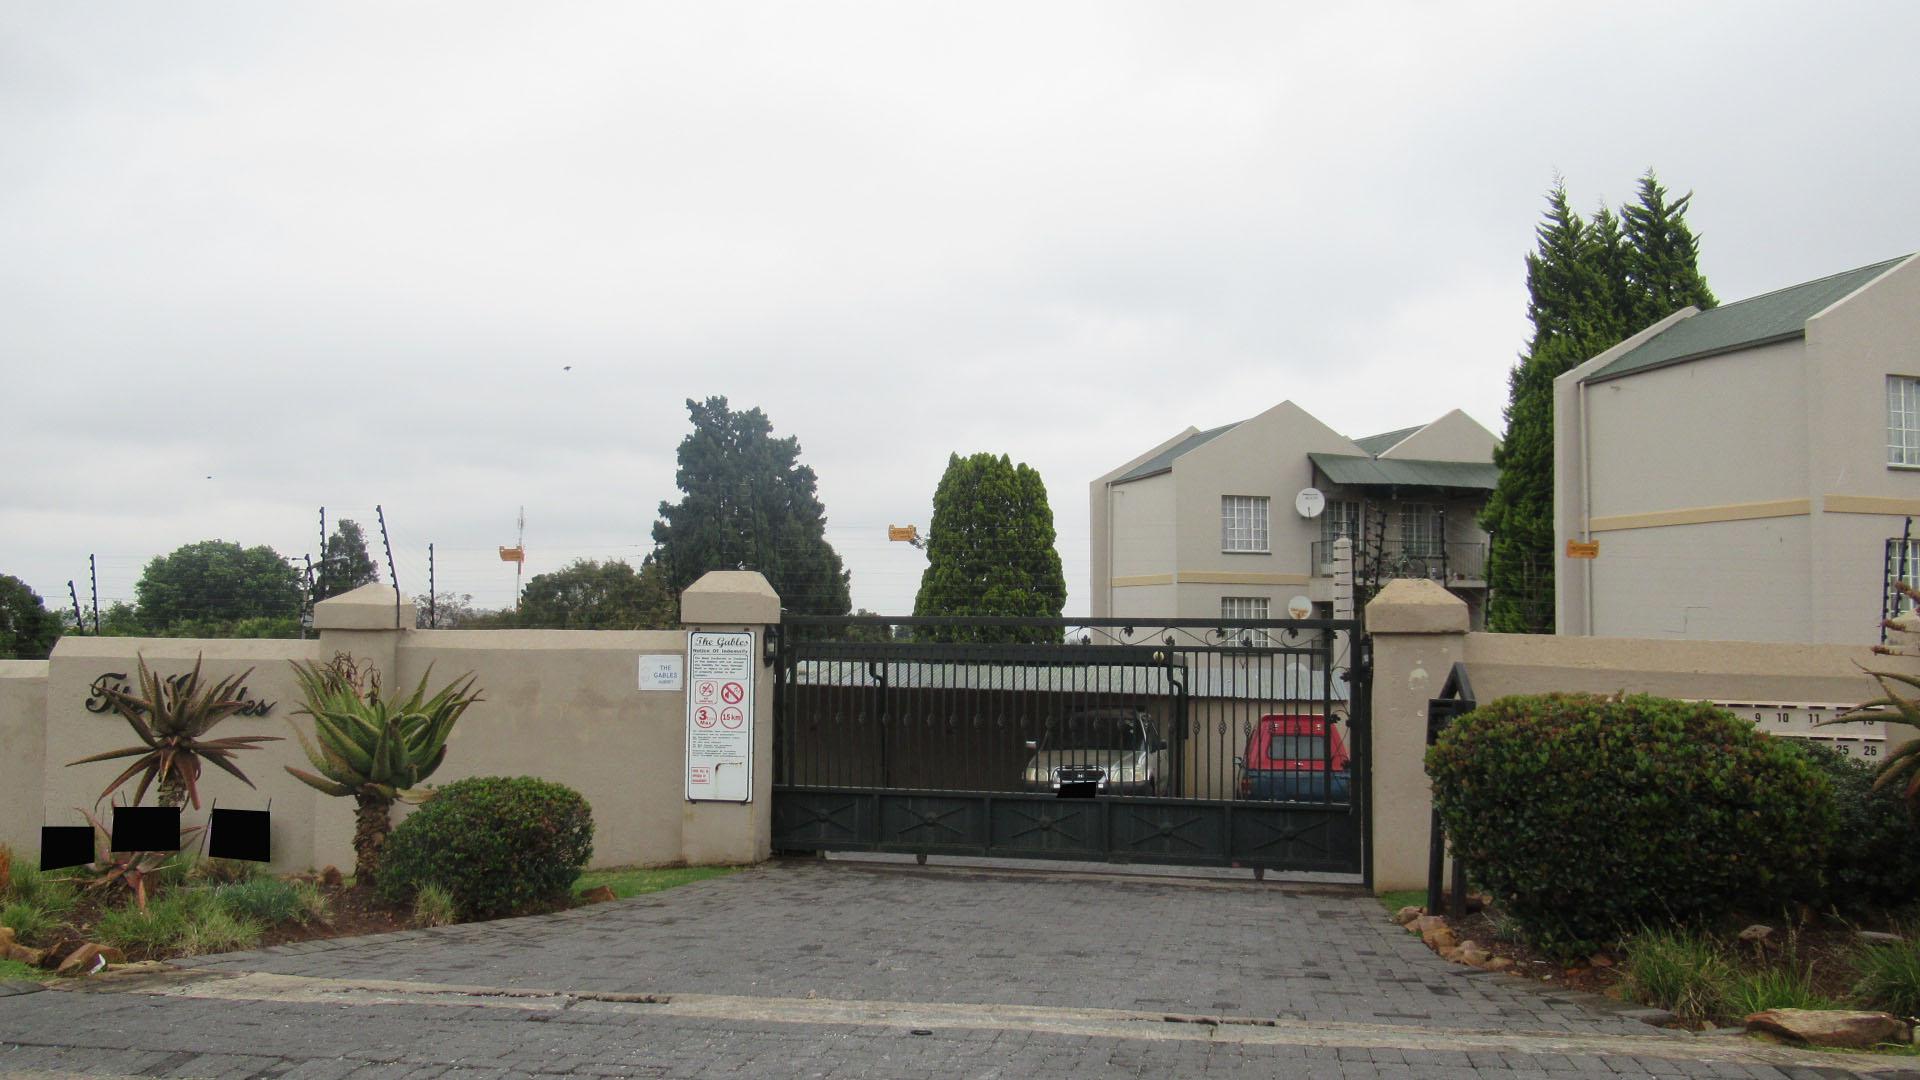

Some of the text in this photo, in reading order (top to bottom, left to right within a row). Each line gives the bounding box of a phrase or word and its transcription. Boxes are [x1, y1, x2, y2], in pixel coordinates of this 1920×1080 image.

[696, 636, 749, 648] The Gables
[699, 709, 707, 721] 3
[1755, 712, 1761, 723] 9
[1776, 712, 1789, 723] 10
[1808, 713, 1820, 724] 11
[1863, 745, 1877, 756] 26
